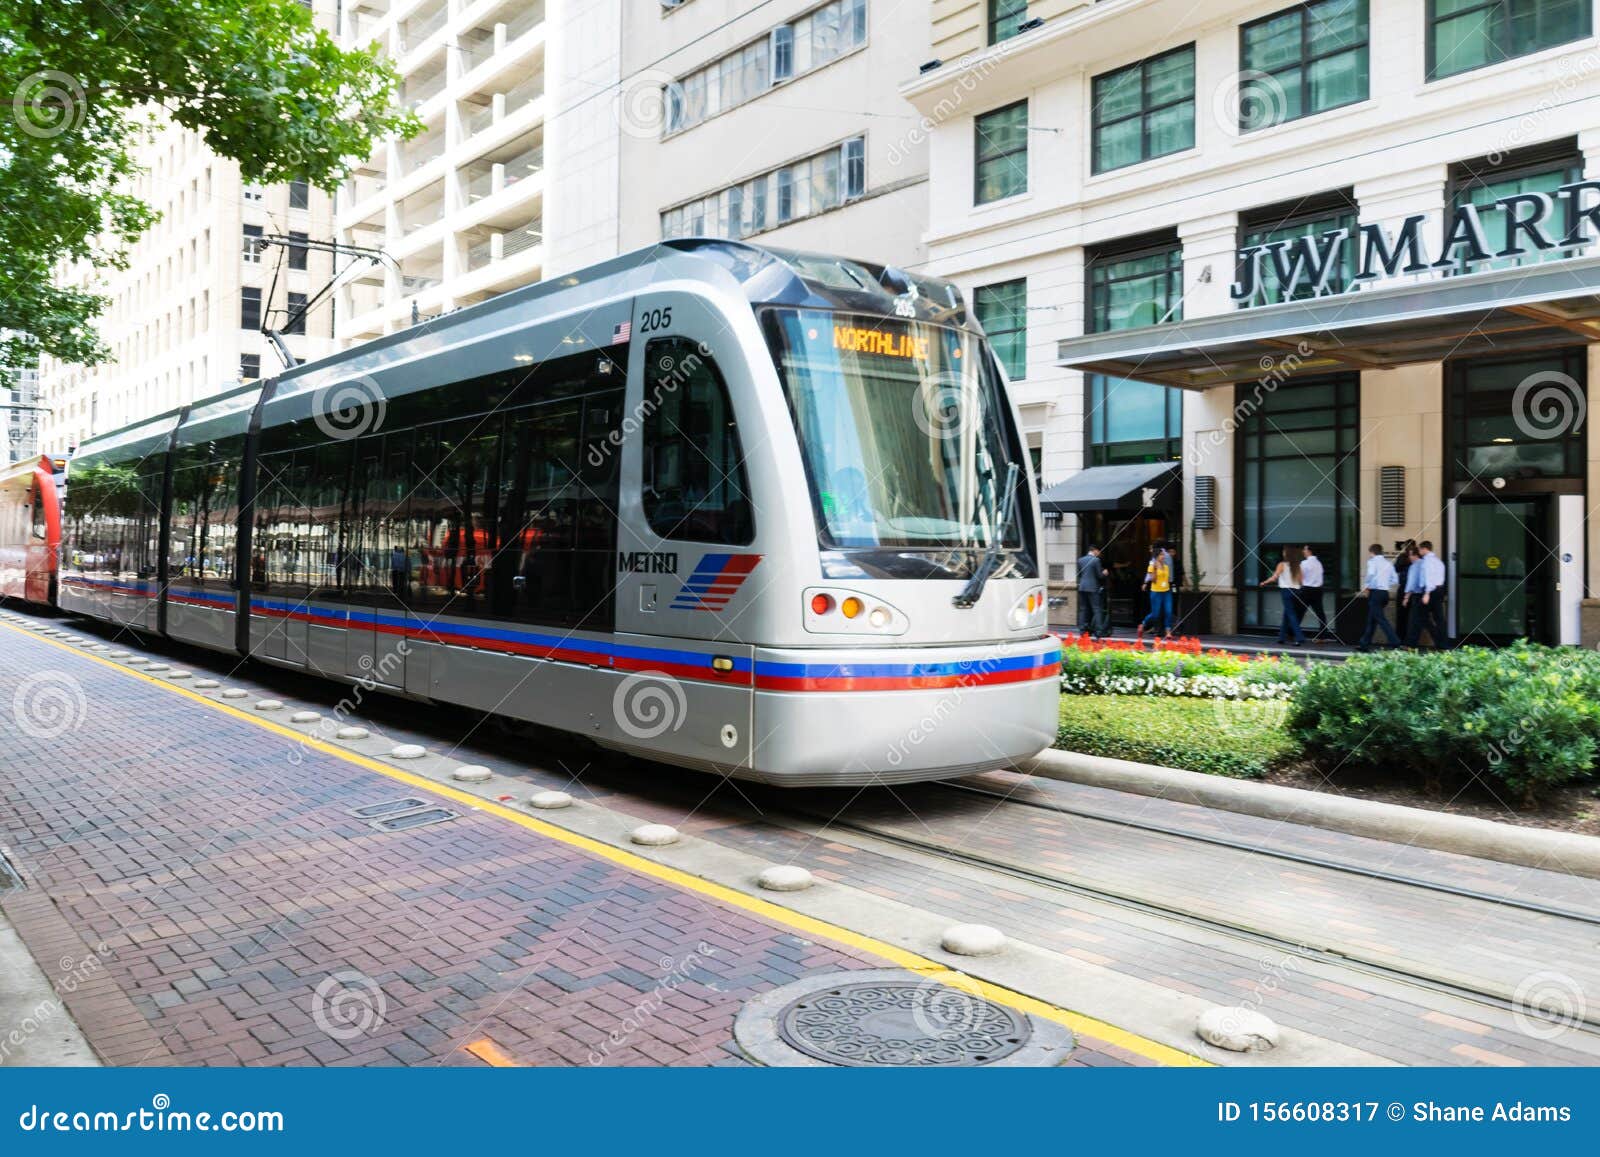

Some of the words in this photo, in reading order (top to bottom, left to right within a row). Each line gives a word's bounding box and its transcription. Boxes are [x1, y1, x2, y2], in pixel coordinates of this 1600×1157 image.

[1230, 230, 1346, 299] JW
[640, 307, 672, 333] 205
[618, 551, 678, 575] METRO
